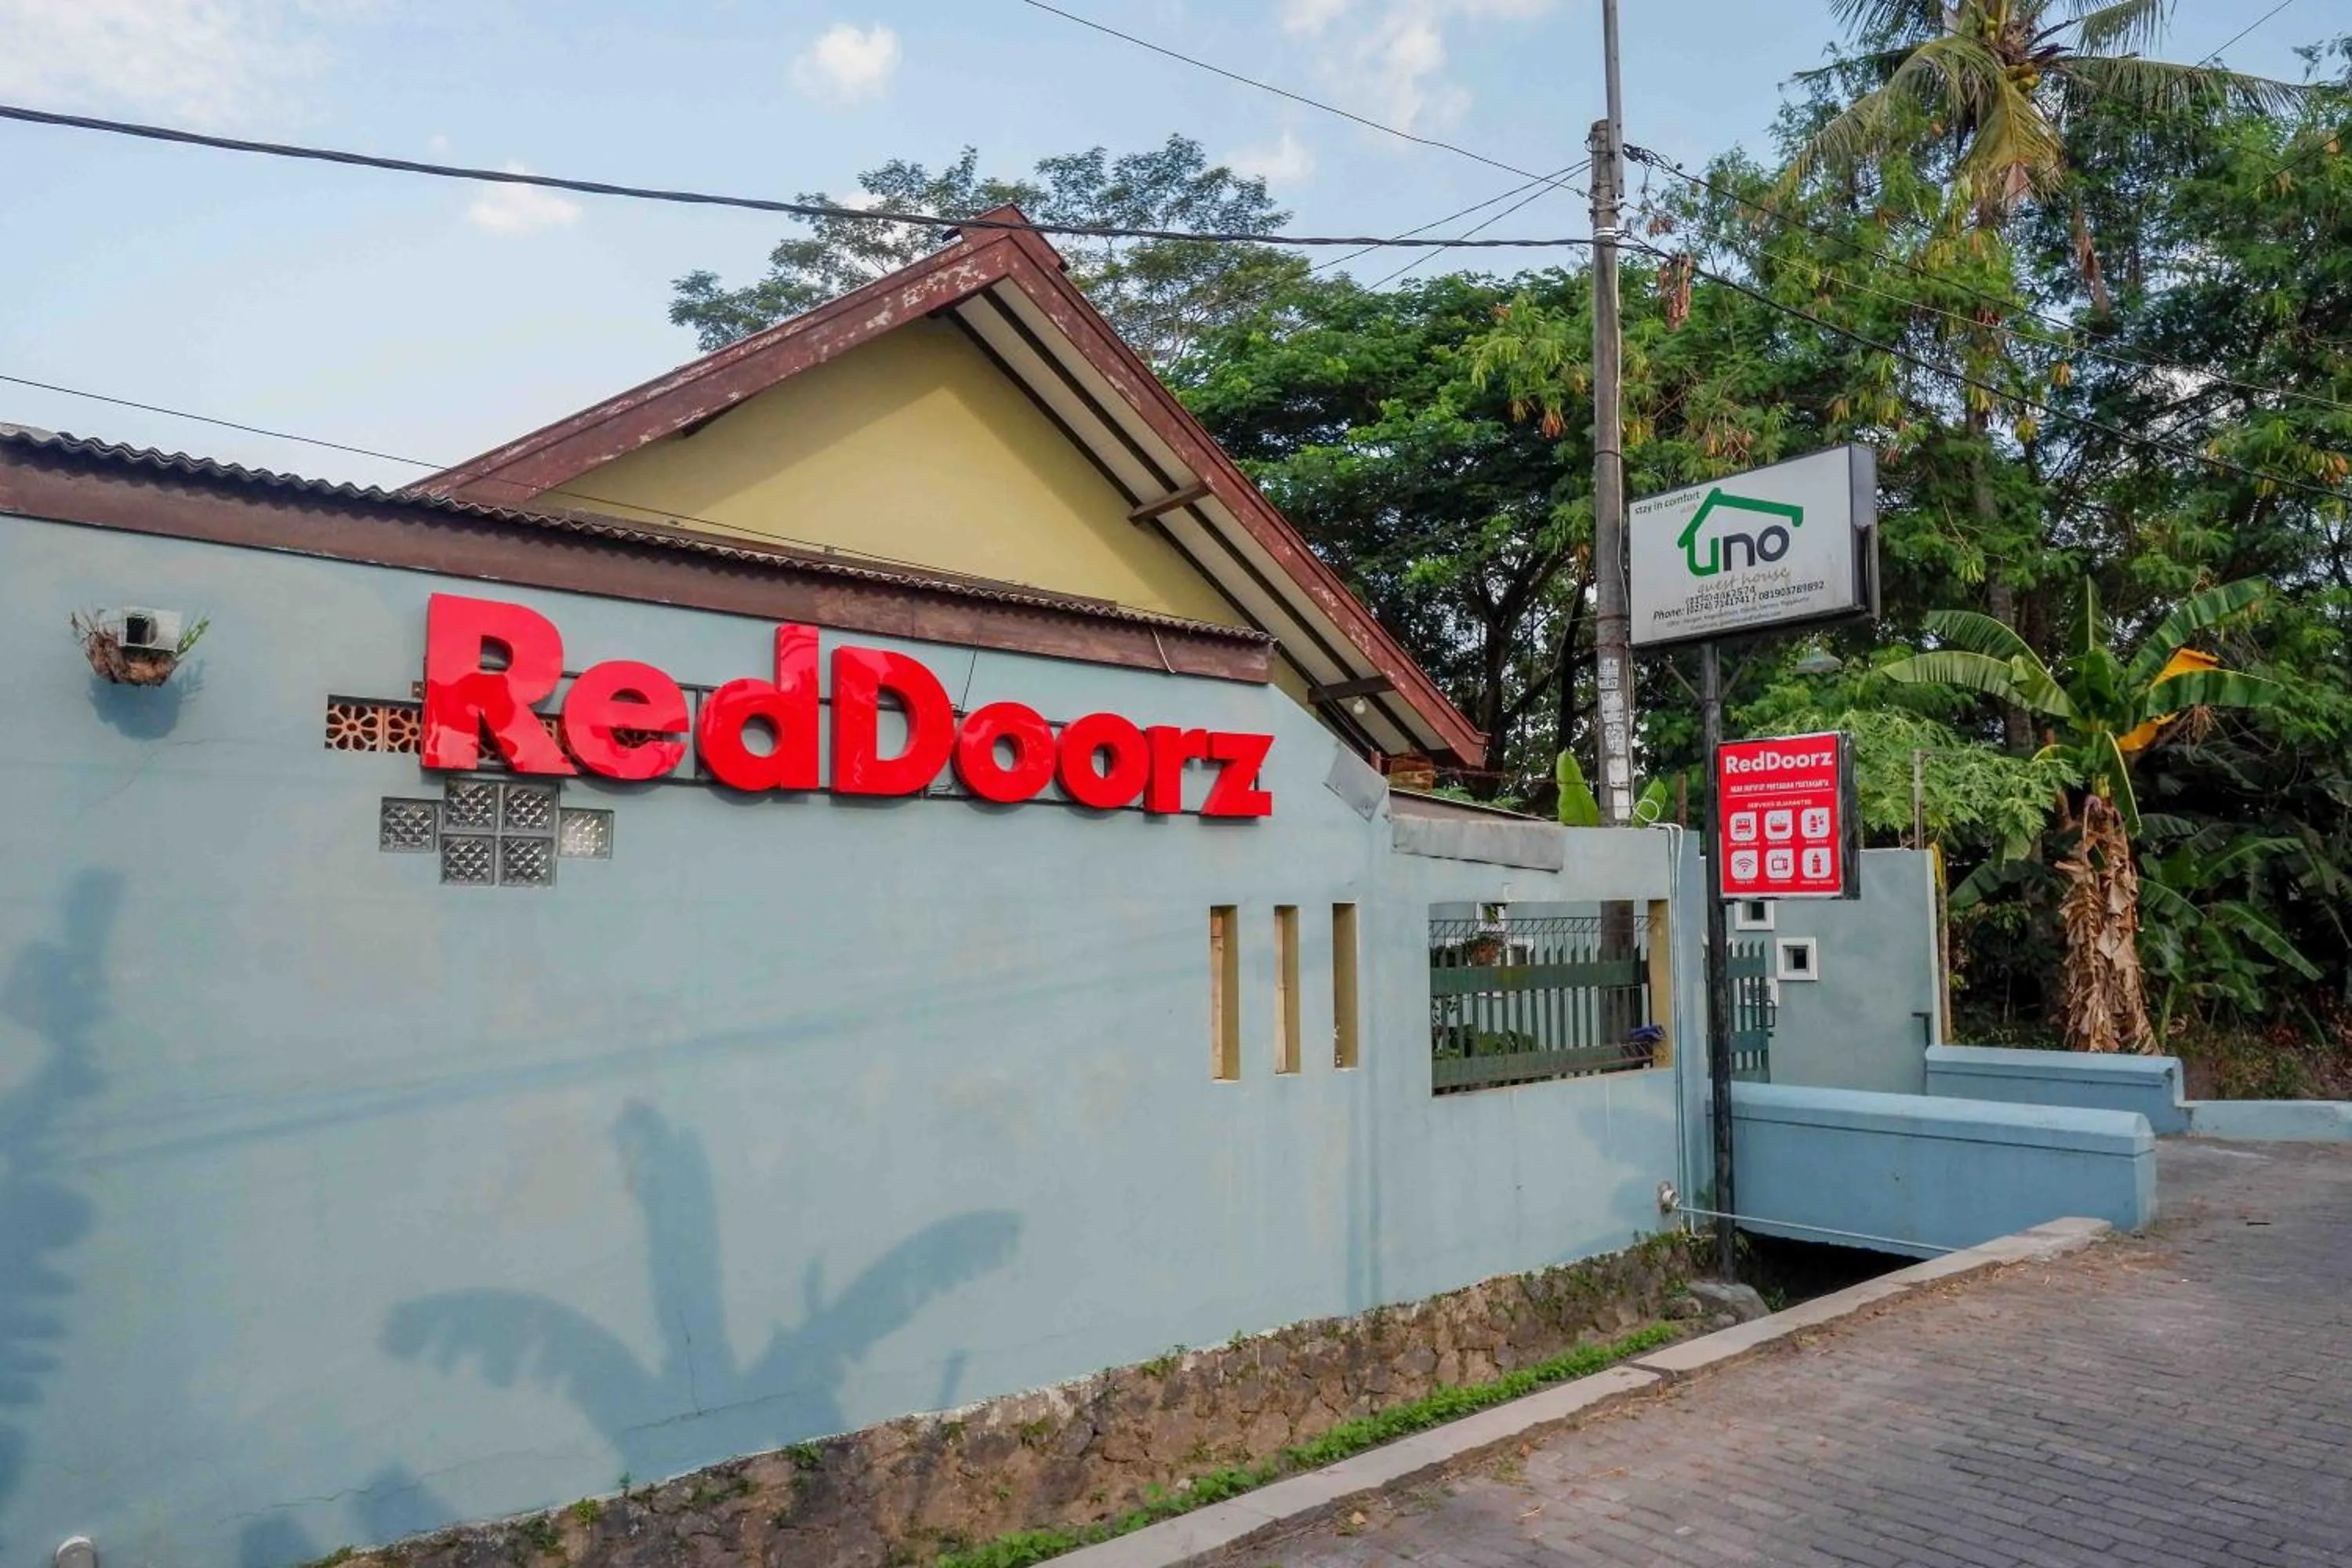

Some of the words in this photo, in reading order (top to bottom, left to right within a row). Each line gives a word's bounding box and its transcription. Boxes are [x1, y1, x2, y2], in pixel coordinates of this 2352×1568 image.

[1654, 501, 1663, 510] in
[1664, 491, 1700, 507] comfort
[1742, 566, 1791, 586] house
[1653, 608, 1685, 620] Phone:
[421, 593, 1273, 817] RedDoorz
[1726, 751, 1832, 774] RedDoorz
